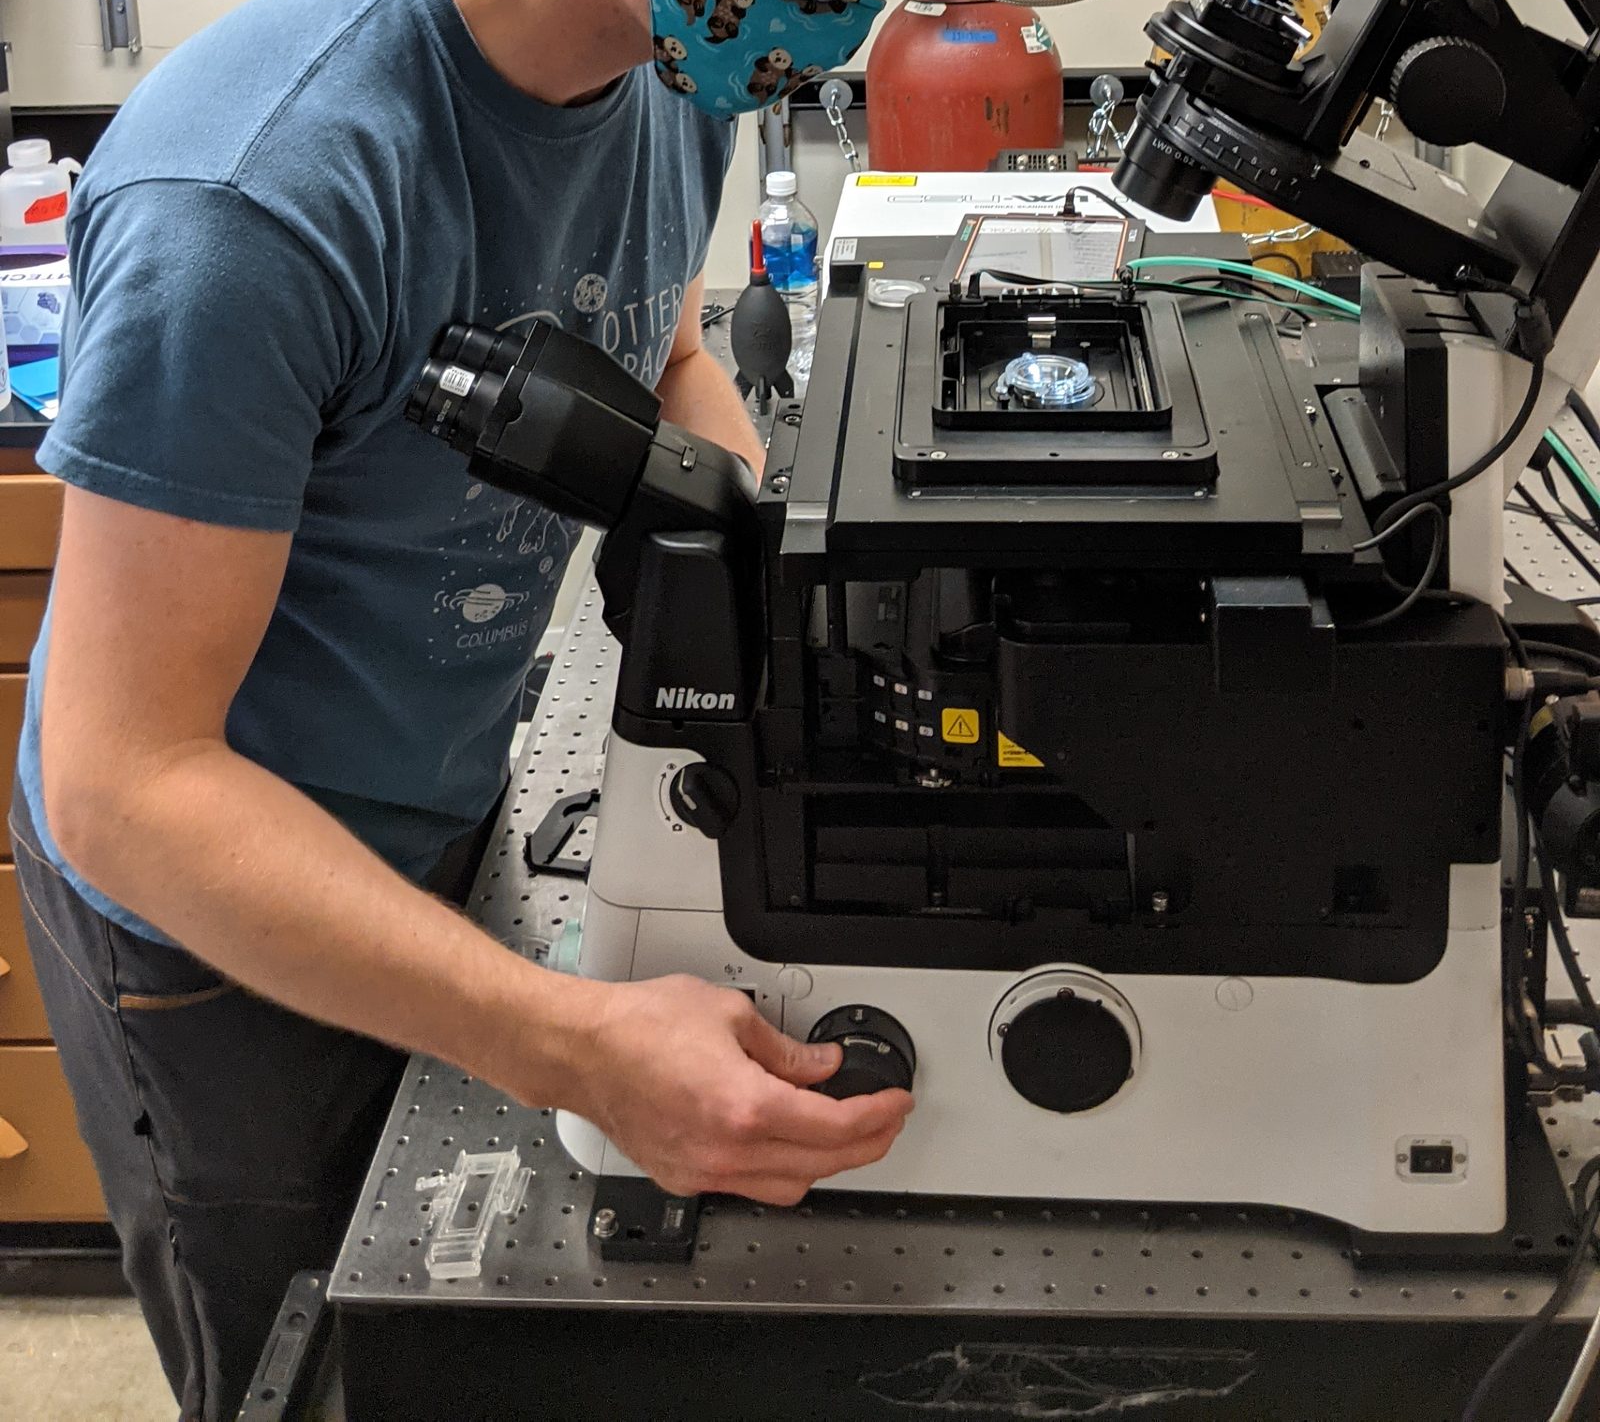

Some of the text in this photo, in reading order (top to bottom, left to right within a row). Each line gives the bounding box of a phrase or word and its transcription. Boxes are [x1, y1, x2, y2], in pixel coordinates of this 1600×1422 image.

[1152, 138, 1172, 155] LWD
[602, 283, 683, 354] OTTER
[623, 332, 674, 382] PAC
[456, 619, 529, 649] COLUMBUS
[656, 687, 735, 709] Nikon
